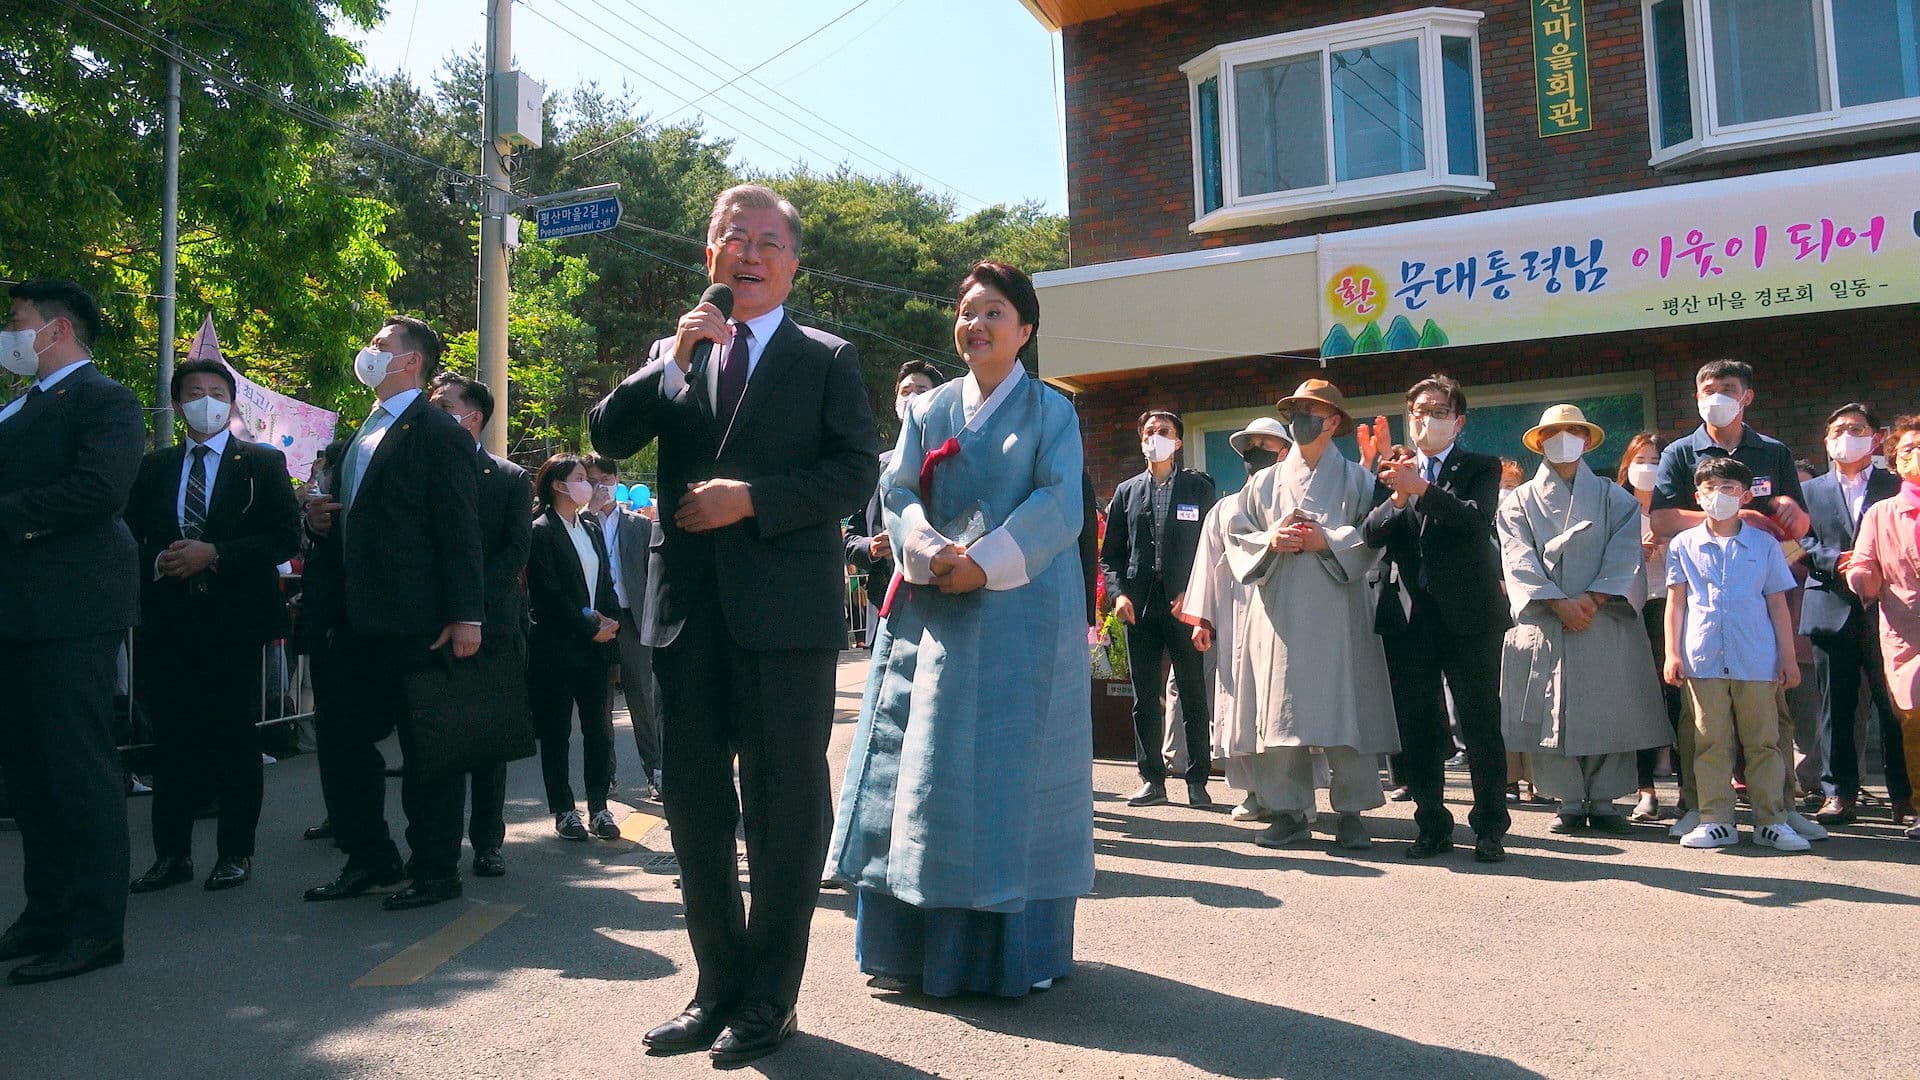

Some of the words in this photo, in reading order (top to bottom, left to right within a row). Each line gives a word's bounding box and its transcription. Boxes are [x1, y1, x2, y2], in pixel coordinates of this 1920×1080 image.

[540, 204, 599, 225] 평산마을2길
[540, 222, 594, 238] Pyeongsanmaeul
[595, 217, 611, 229] 2-gil
[1334, 277, 1376, 314] 환
[1393, 238, 1609, 310] 문대통령님
[1632, 225, 1768, 279] 이웃이
[1785, 215, 1885, 263] 되어
[1662, 294, 1701, 316] 평산
[1708, 290, 1747, 312] 마을
[1754, 283, 1813, 308] 경로회
[1829, 278, 1872, 299] 일동
